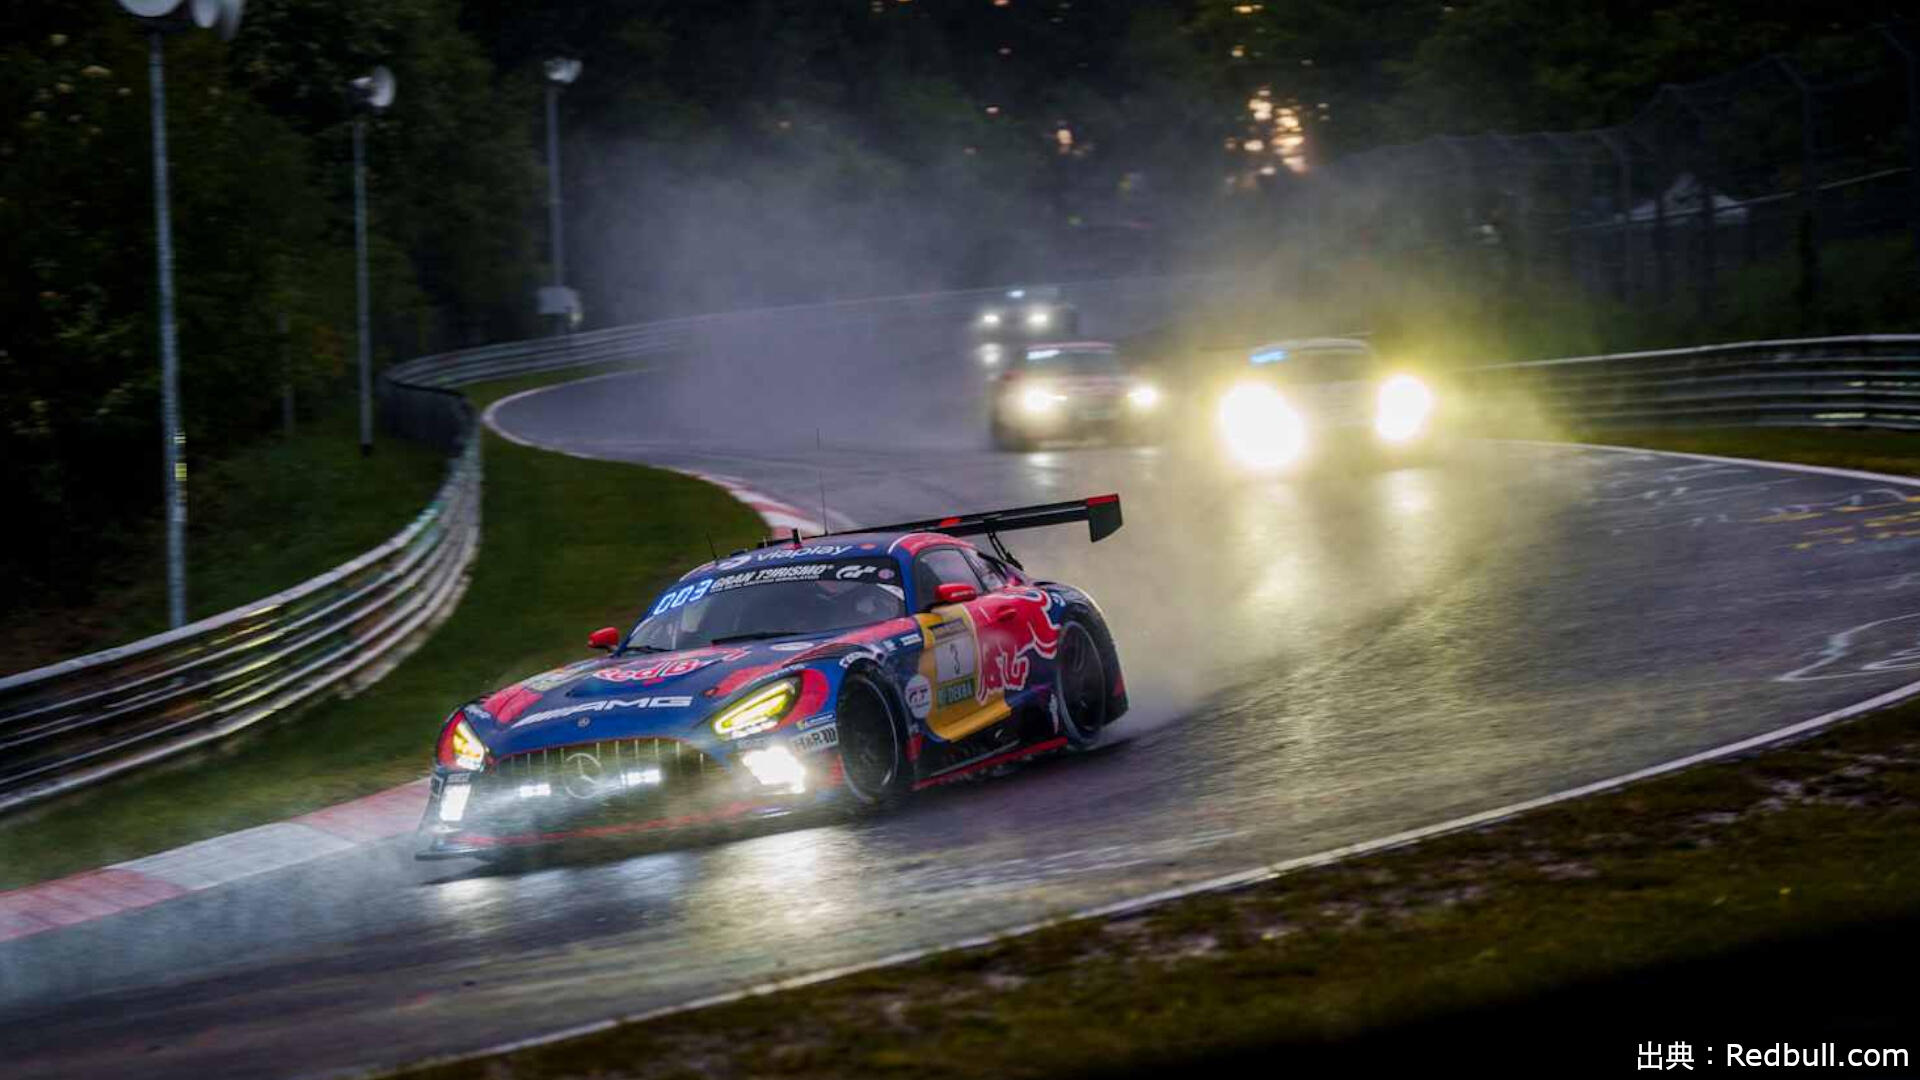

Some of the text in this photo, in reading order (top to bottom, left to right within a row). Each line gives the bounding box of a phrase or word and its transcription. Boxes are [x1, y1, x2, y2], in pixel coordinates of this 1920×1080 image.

[756, 545, 853, 562] viaplay
[711, 571, 756, 589] GRAN
[653, 579, 714, 616] 003
[950, 642, 962, 676] 3
[571, 696, 694, 712] AMG
